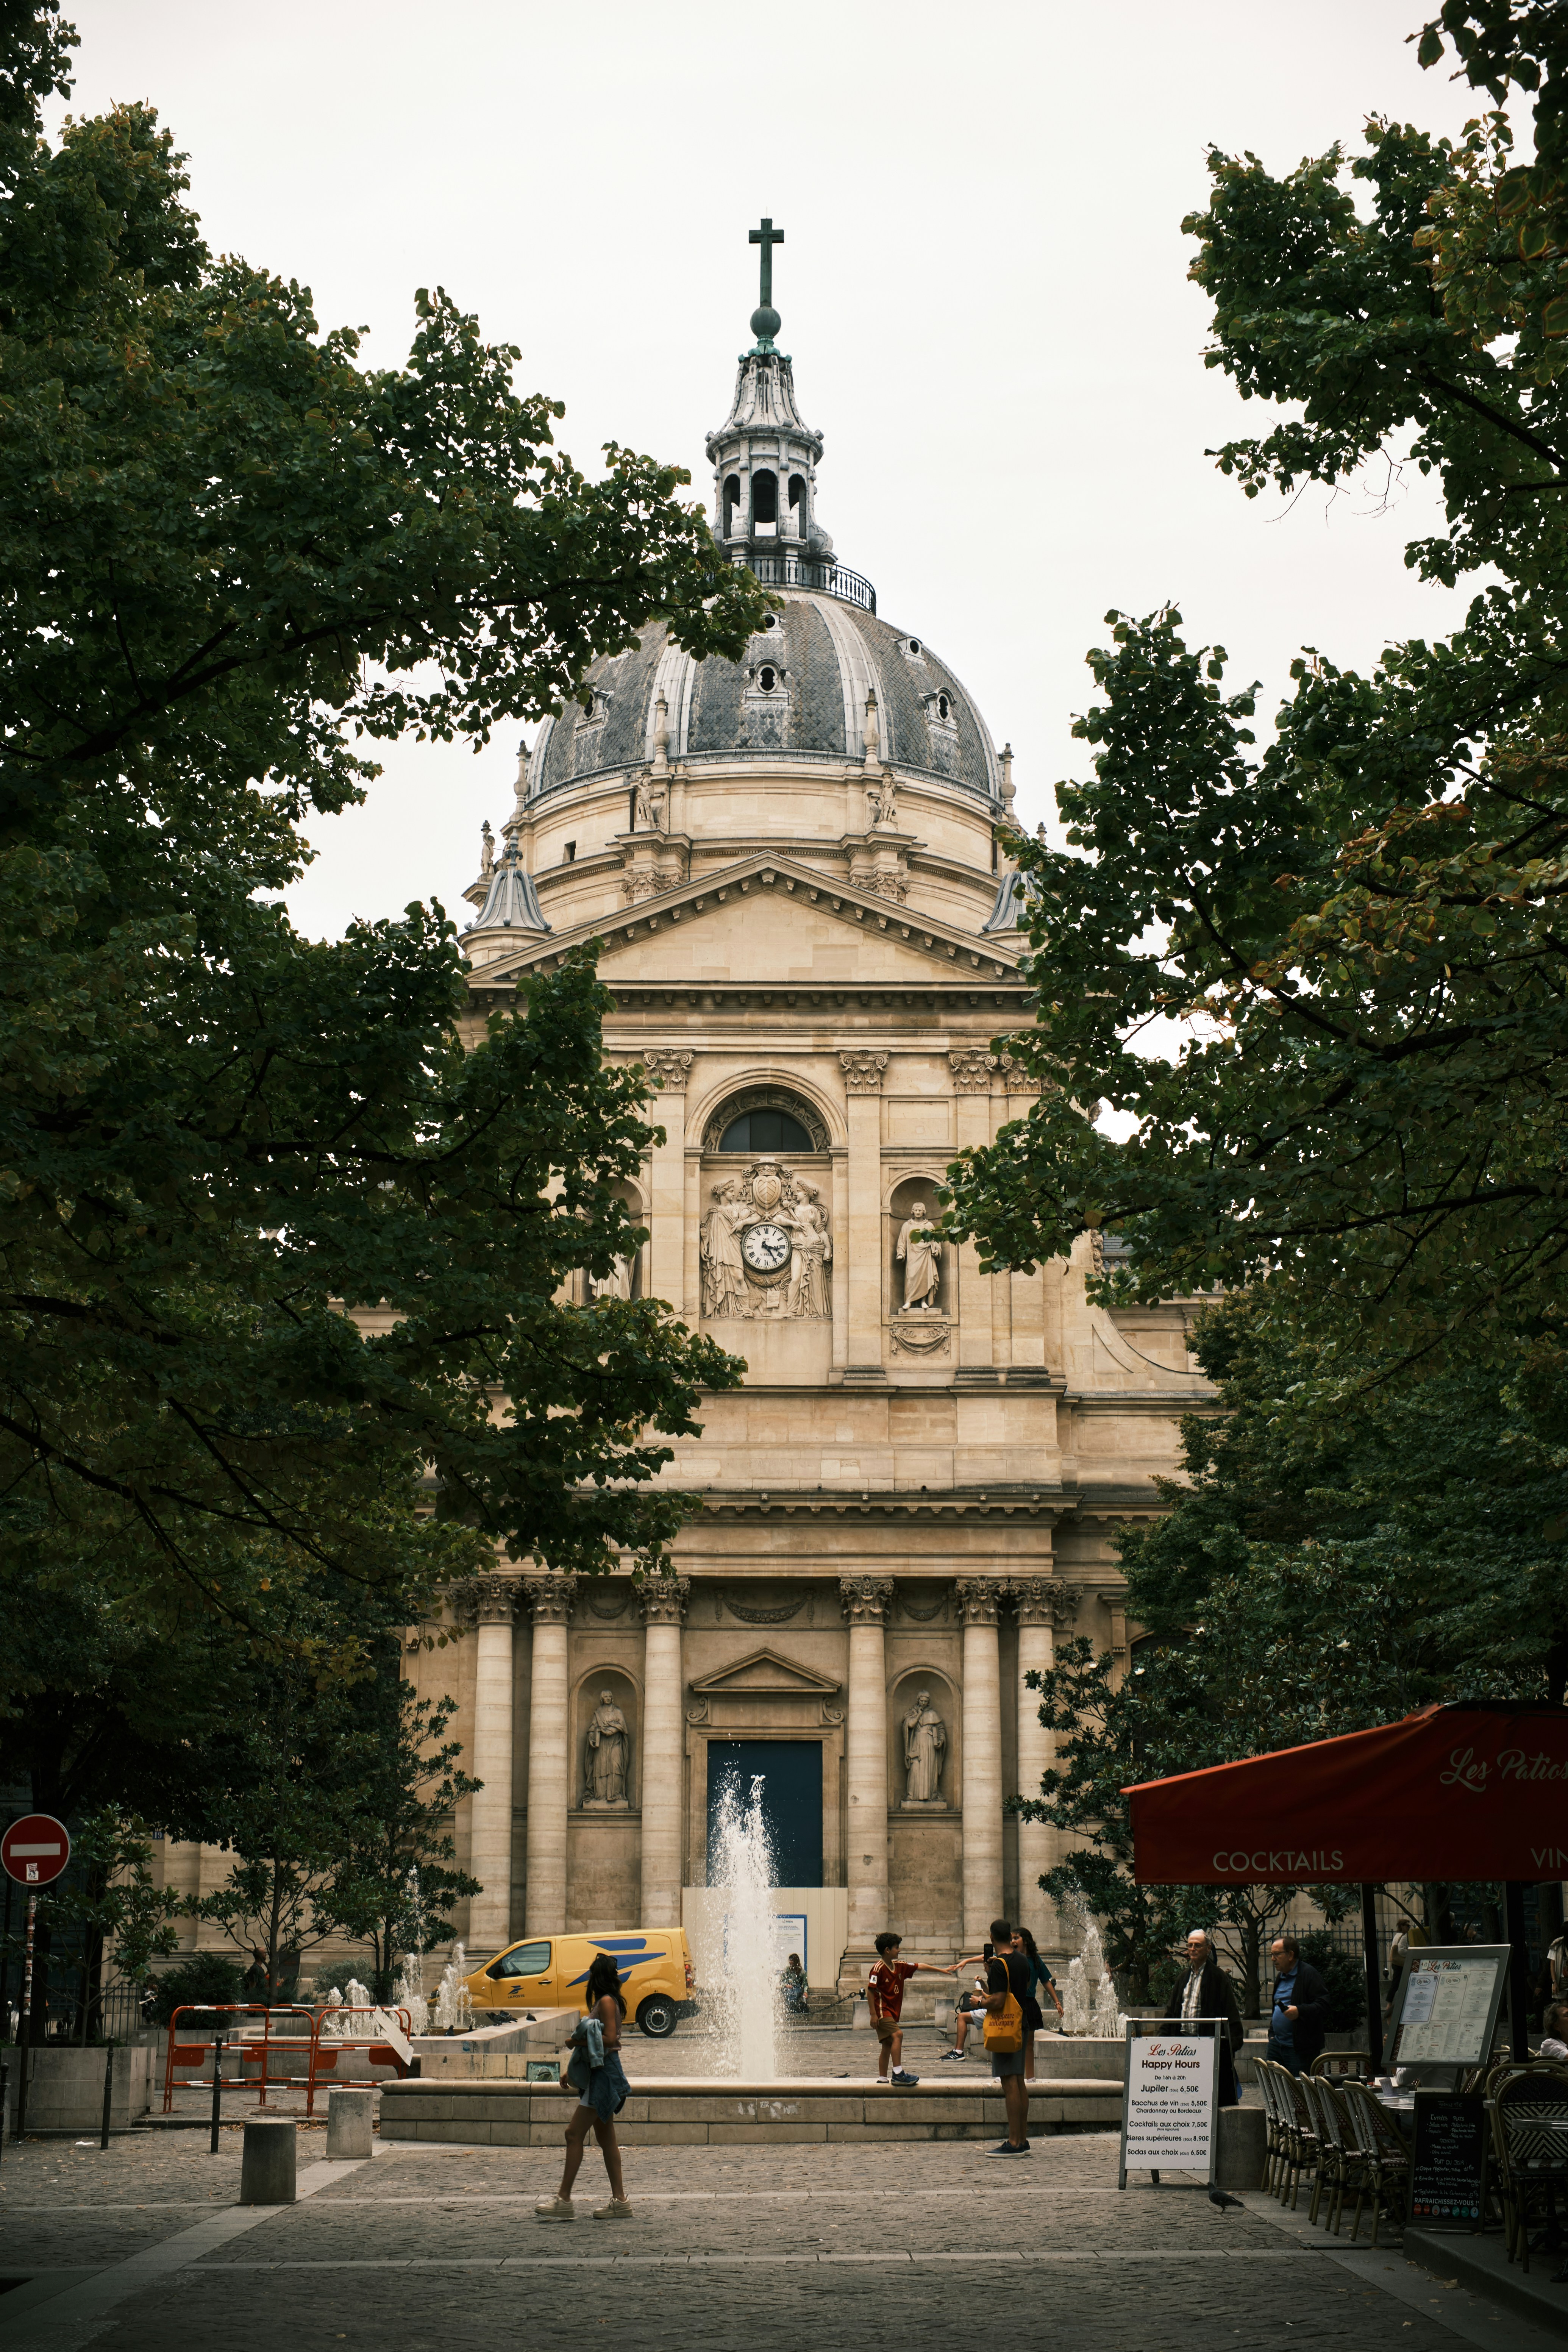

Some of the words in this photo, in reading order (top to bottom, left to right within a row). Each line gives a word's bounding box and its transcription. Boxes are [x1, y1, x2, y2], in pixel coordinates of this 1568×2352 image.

[1440, 1747, 1493, 1793] Les
[1497, 1749, 1568, 1780] Patios
[1213, 1851, 1343, 1872] COCKTAILS
[1427, 1960, 1441, 1972] Les
[1442, 1961, 1462, 1970] Patios
[1147, 2044, 1166, 2056] Les
[1167, 2044, 1197, 2056] Patios
[1142, 2060, 1172, 2070] Happy
[1175, 2060, 1200, 2068] Hours
[1141, 2085, 1168, 2093] Jupiler
[1414, 2197, 1474, 2206] RAFRAICHISSEZ-VOUS
